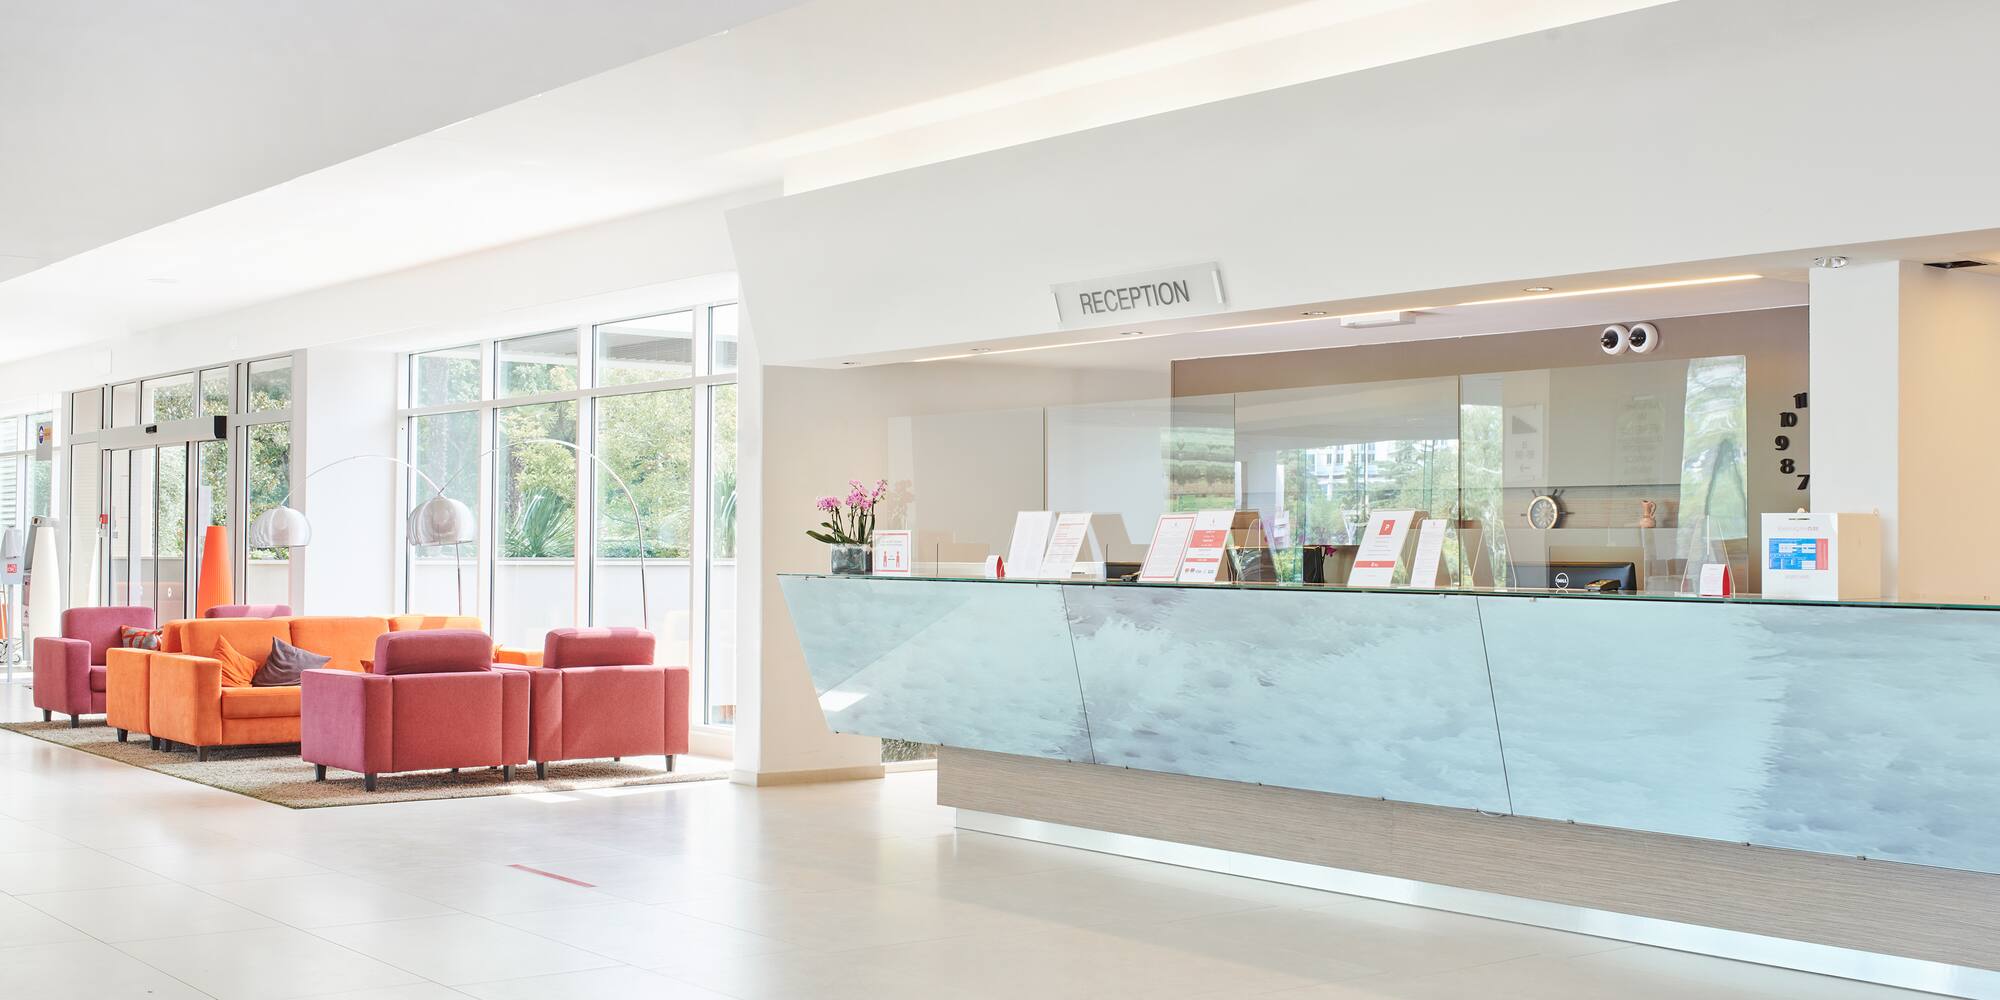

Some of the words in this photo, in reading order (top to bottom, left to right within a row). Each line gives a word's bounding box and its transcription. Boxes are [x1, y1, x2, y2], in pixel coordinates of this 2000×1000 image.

[1079, 280, 1190, 314] RECEPTION
[1775, 435, 1790, 450] 9
[1780, 459, 1795, 474] 8
[1797, 475, 1810, 490] 7
